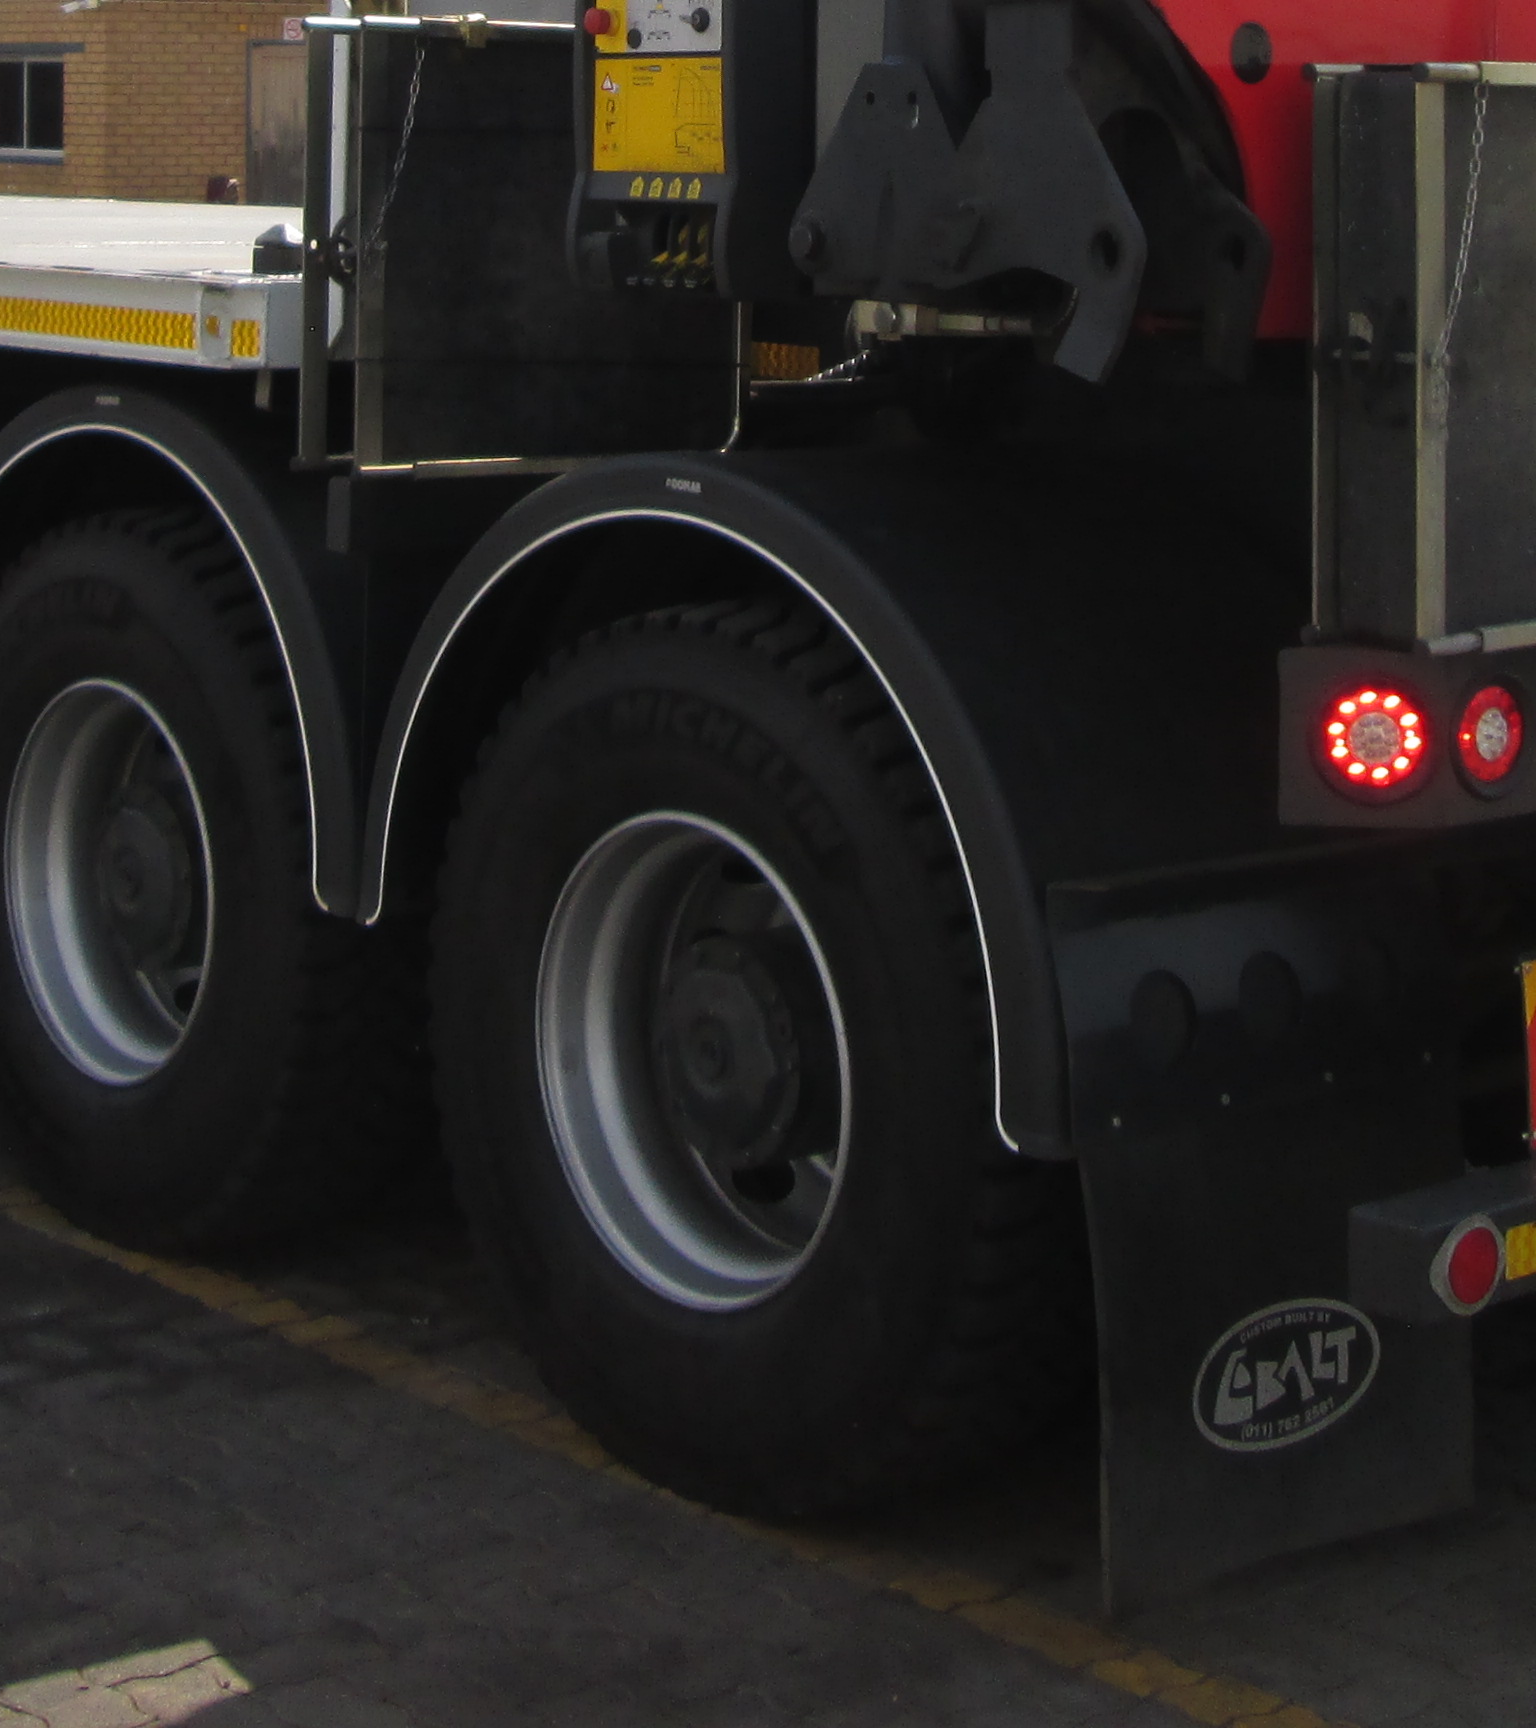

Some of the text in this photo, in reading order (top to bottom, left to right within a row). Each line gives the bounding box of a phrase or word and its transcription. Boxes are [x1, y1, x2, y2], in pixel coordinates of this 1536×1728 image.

[1240, 1310, 1331, 1345] CUSTOM BUILT BY
[1240, 1421, 1272, 1442] (011)
